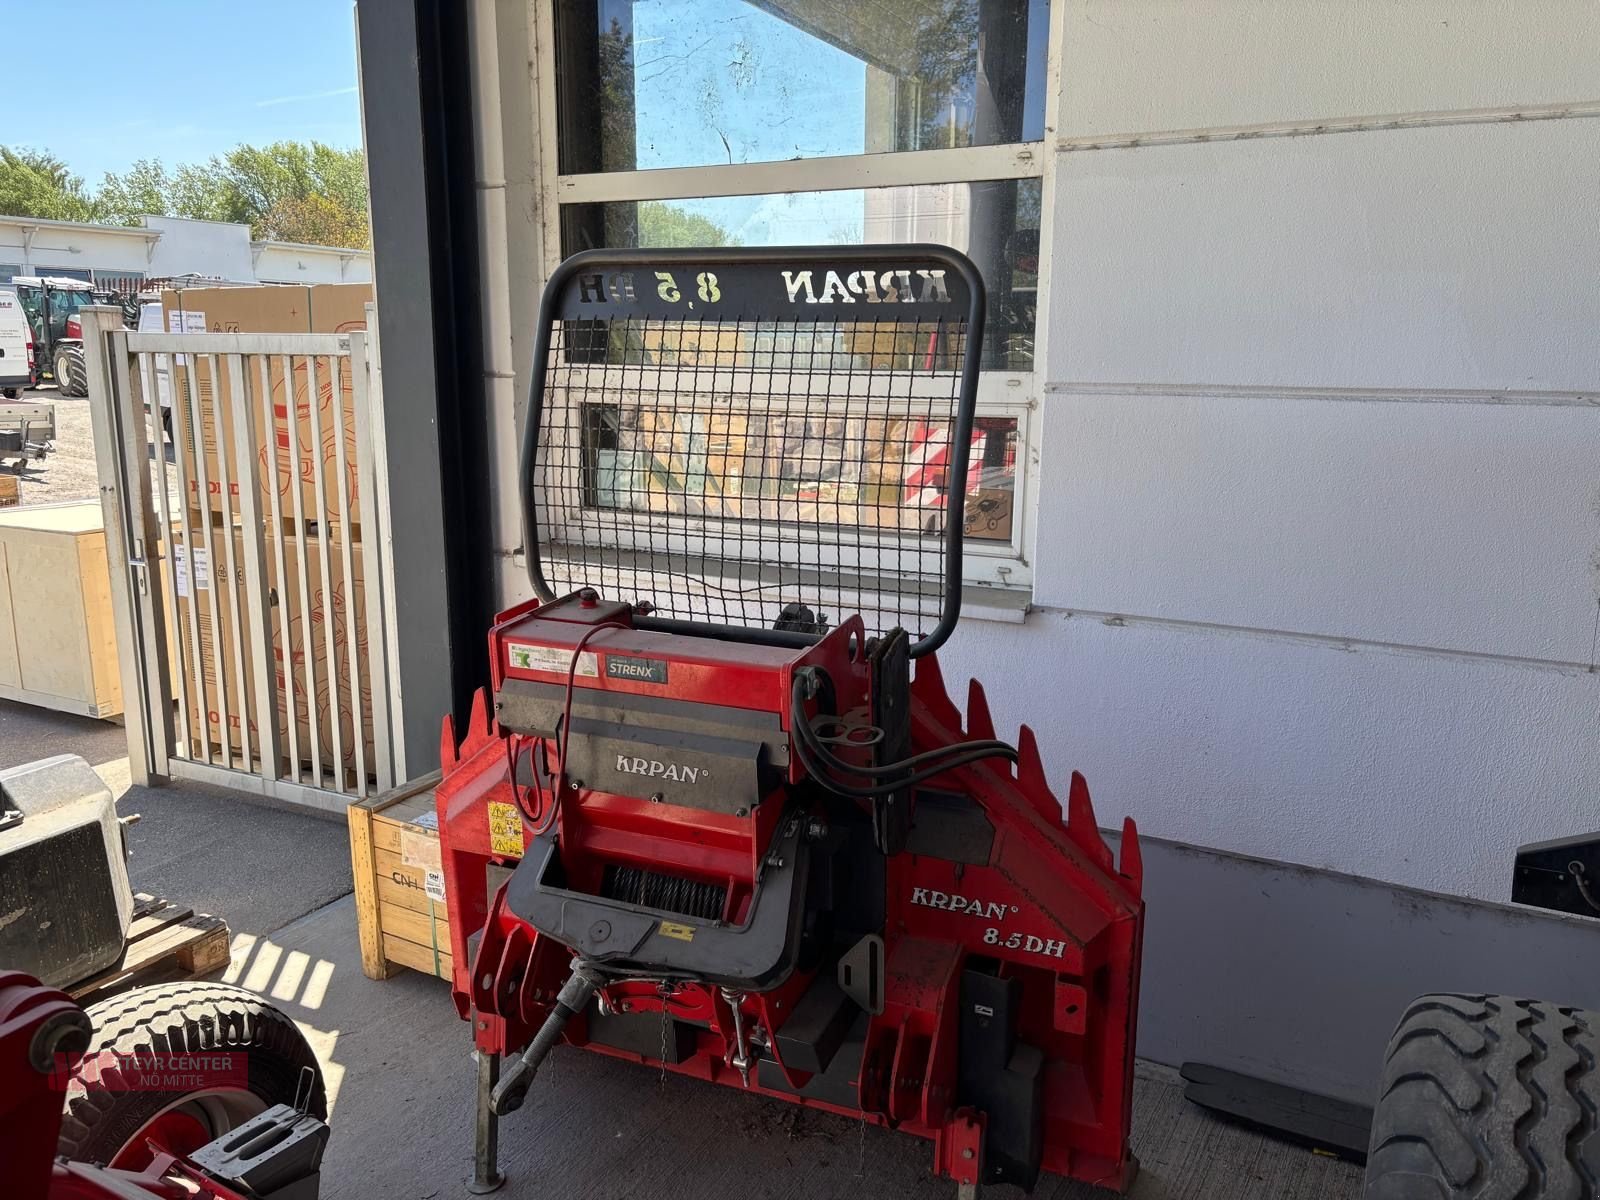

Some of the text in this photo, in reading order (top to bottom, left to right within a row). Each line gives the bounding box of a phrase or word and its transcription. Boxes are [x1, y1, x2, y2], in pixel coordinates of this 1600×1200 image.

[609, 663, 653, 678] STRENX
[195, 707, 259, 732] ODA
[616, 754, 699, 784] KRPAN
[910, 887, 1008, 920] KRPAN
